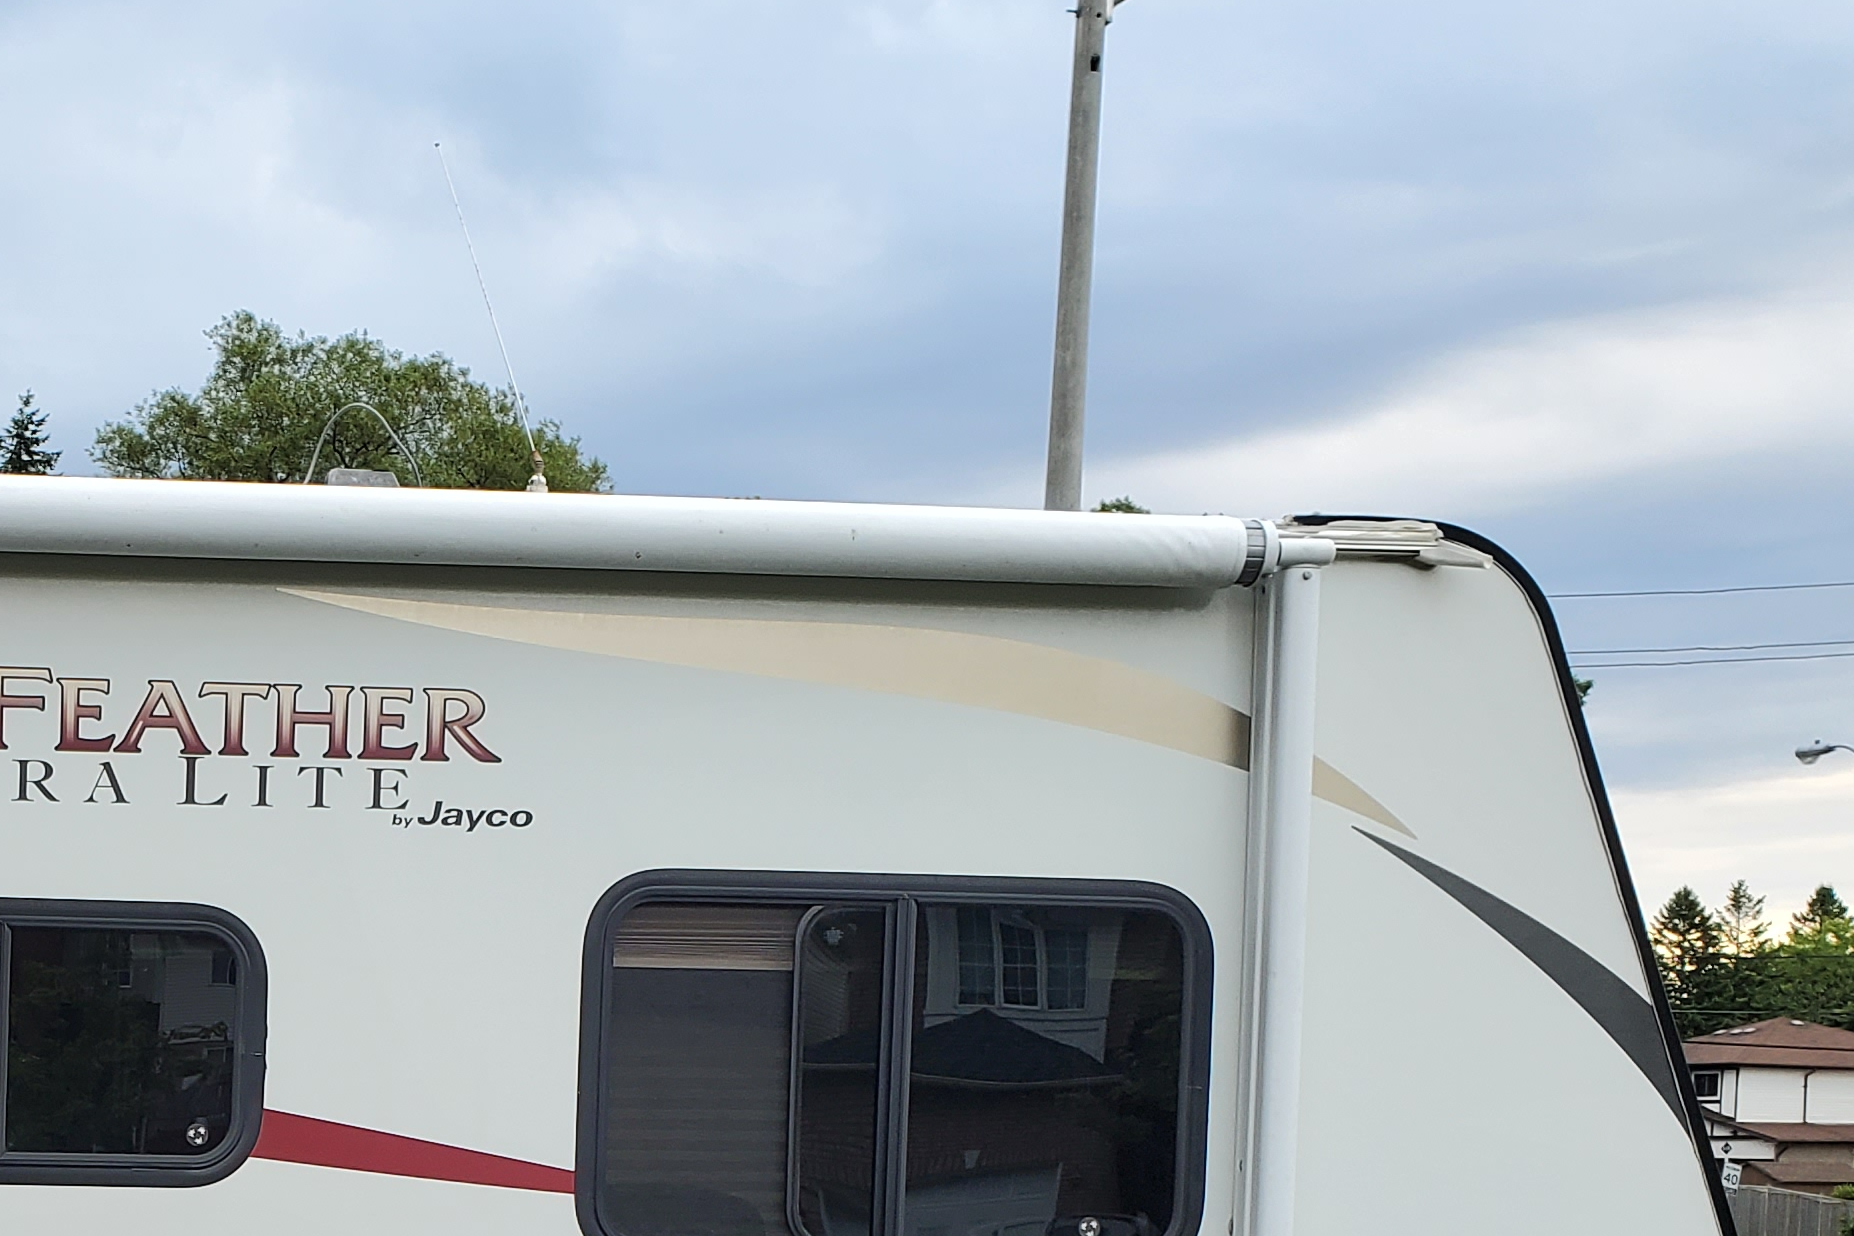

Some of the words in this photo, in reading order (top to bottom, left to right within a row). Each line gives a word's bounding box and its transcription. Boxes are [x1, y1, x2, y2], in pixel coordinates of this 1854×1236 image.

[175, 755, 410, 811] LITE
[391, 812, 414, 828] by
[417, 801, 534, 832] Jayco
[1723, 1173, 1738, 1185] 40
